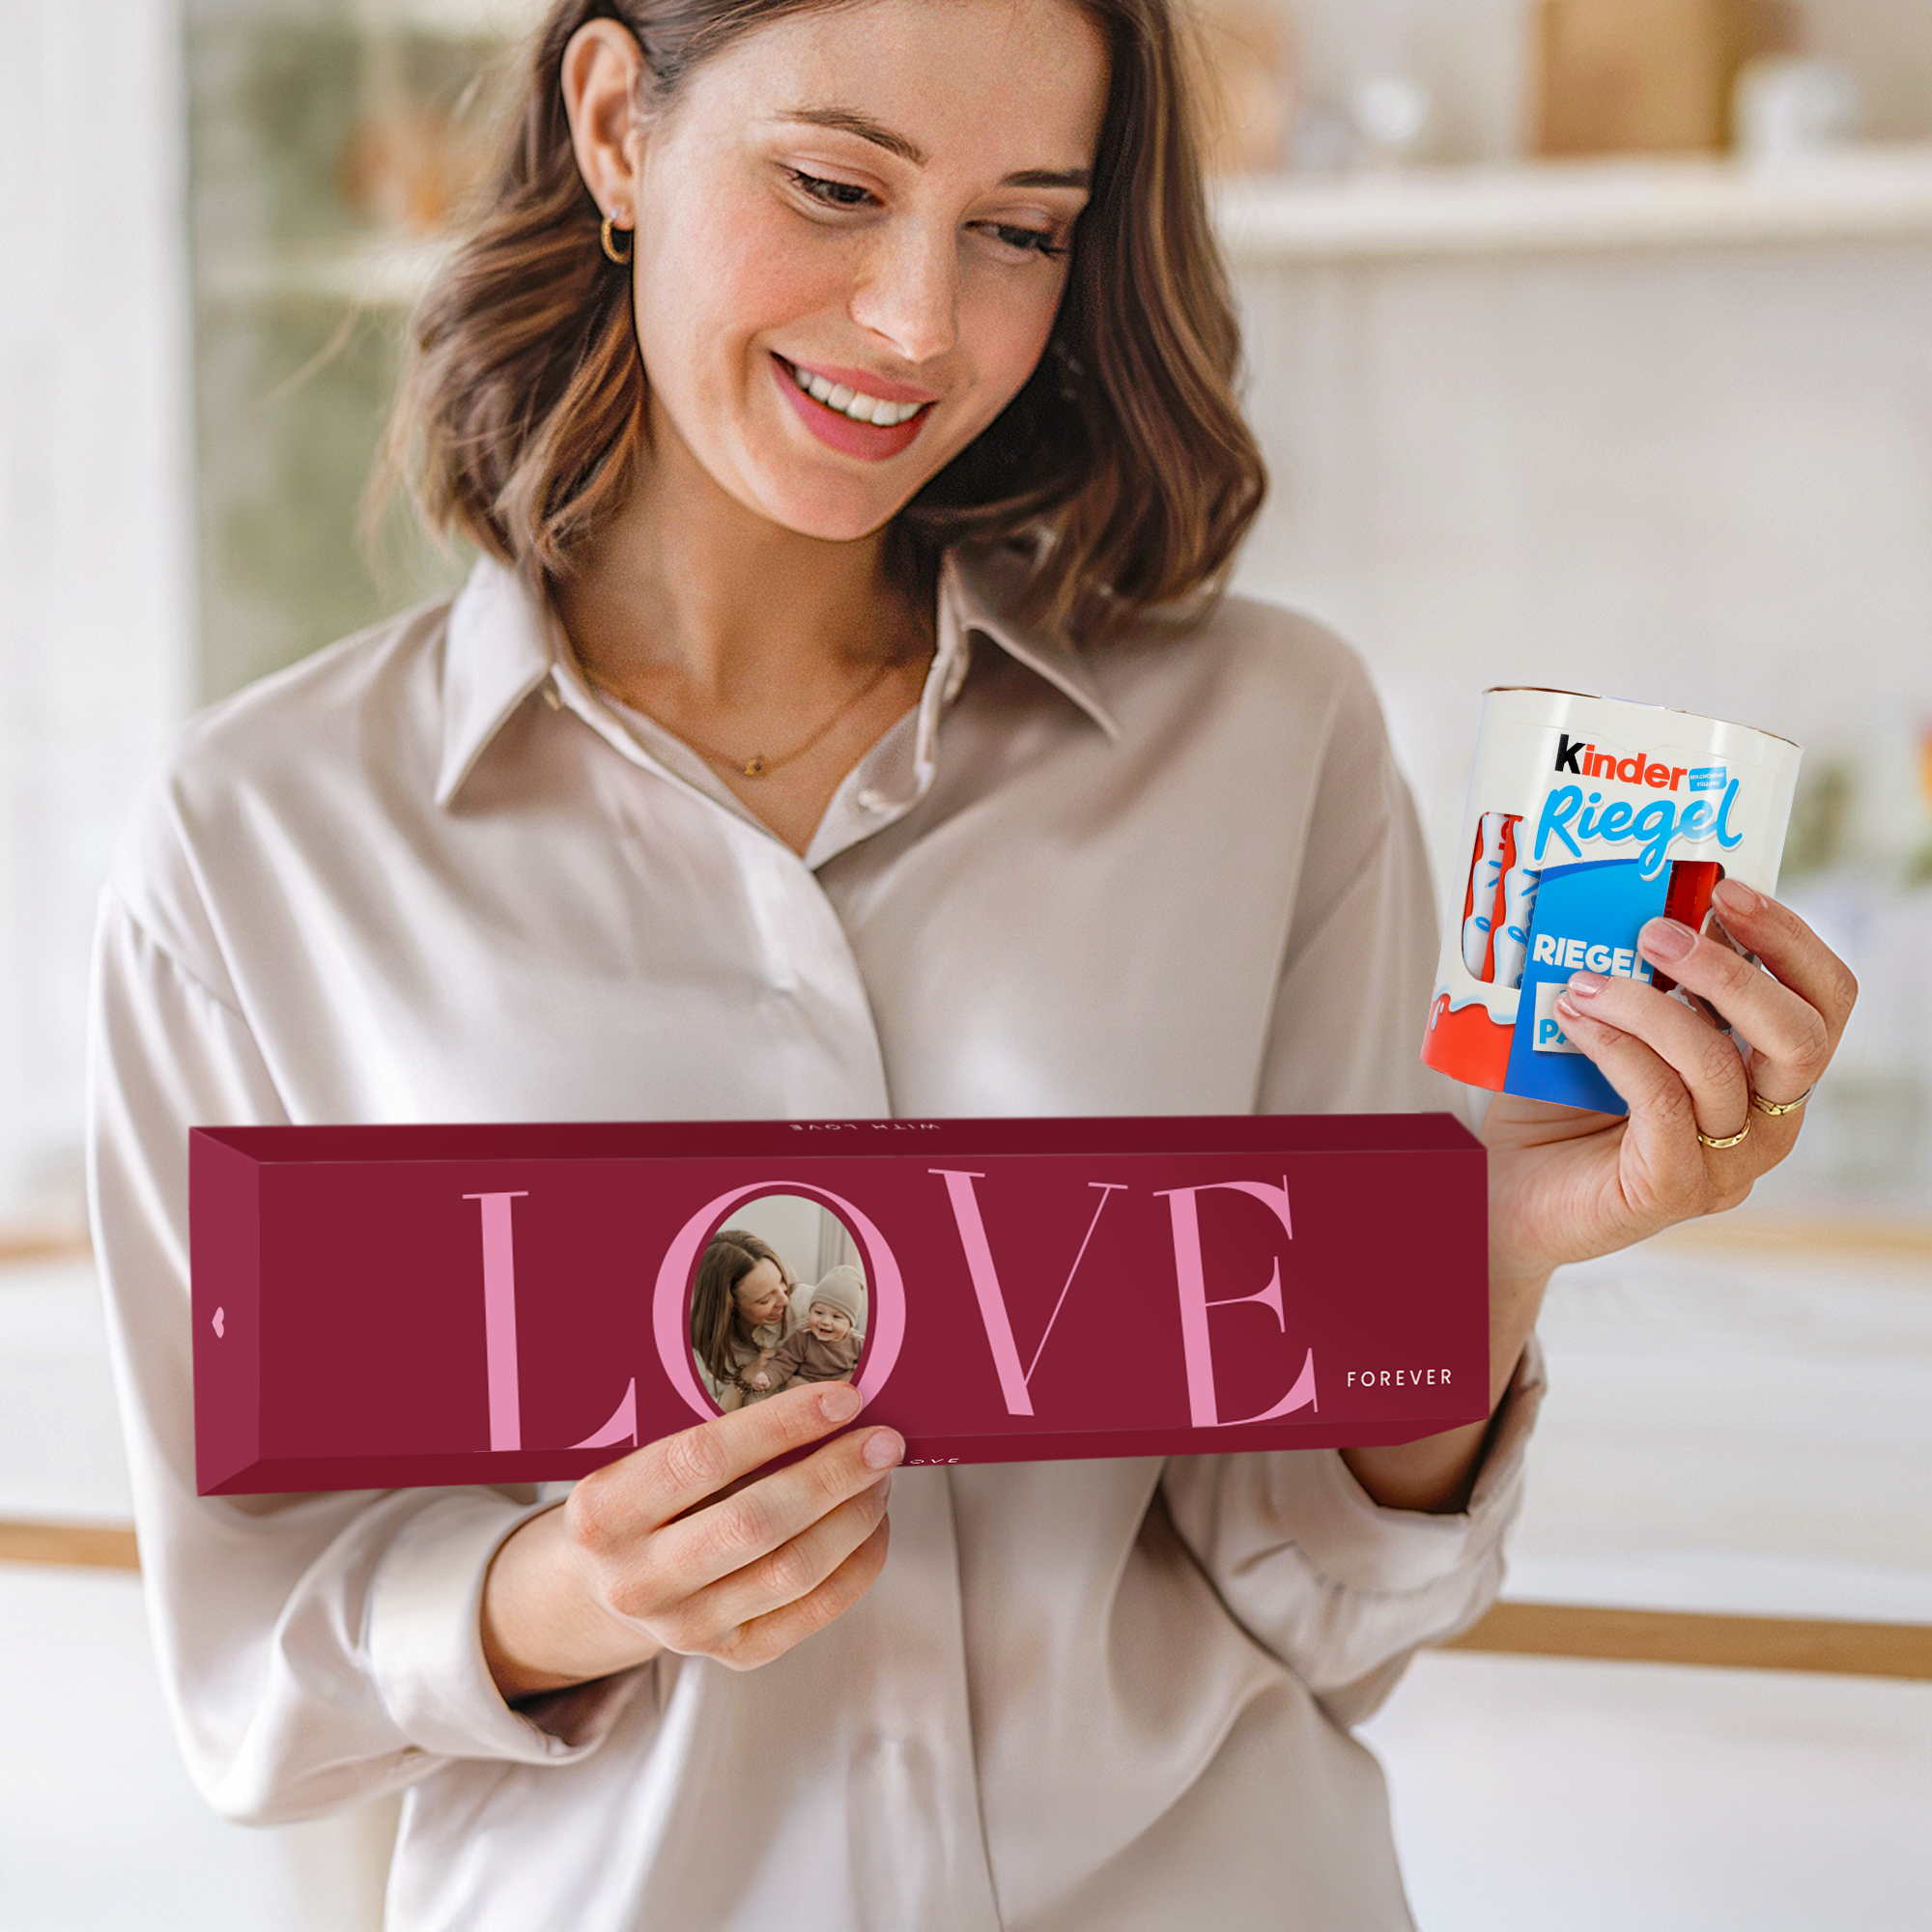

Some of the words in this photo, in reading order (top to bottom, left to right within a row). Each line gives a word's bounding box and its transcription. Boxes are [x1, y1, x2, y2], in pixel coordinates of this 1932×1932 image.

[1533, 778, 1743, 876] Riegel
[1532, 933, 1651, 982] RIEGEL
[462, 1168, 1320, 1452] LOVE
[1348, 1368, 1452, 1388] FOREVER
